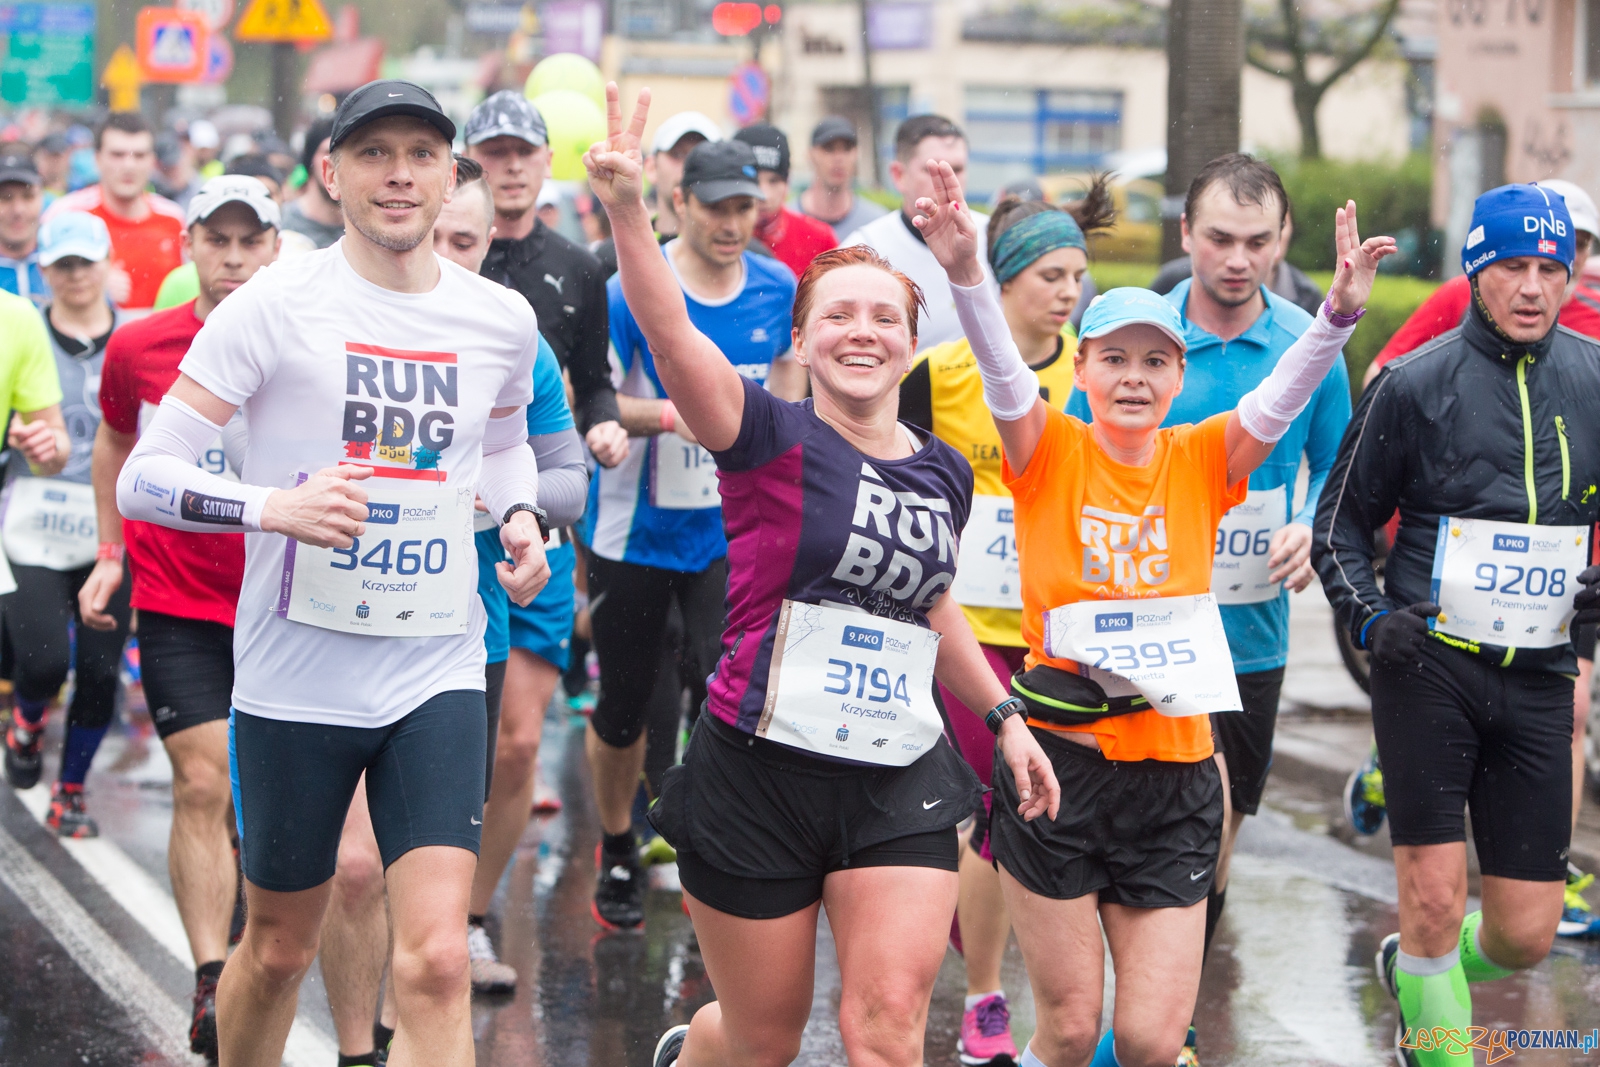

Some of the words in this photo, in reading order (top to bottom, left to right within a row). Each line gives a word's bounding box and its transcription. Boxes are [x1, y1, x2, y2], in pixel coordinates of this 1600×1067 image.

[1523, 209, 1567, 239] DNB
[346, 354, 458, 407] RUN
[342, 400, 455, 452] BDG
[202, 499, 242, 518] SATURN
[852, 479, 957, 564] RUN
[1081, 517, 1168, 552] RUN
[330, 537, 448, 575] 3460
[831, 532, 953, 609] BDG
[1082, 546, 1170, 586] BDG
[362, 580, 418, 593] Krzysztof
[1474, 563, 1566, 597] 9208
[1491, 598, 1548, 611] Przemysław
[1085, 639, 1196, 672] 2395
[824, 658, 912, 707] 3194
[1129, 673, 1165, 681] Anetta
[841, 703, 897, 721] Krzysztofa
